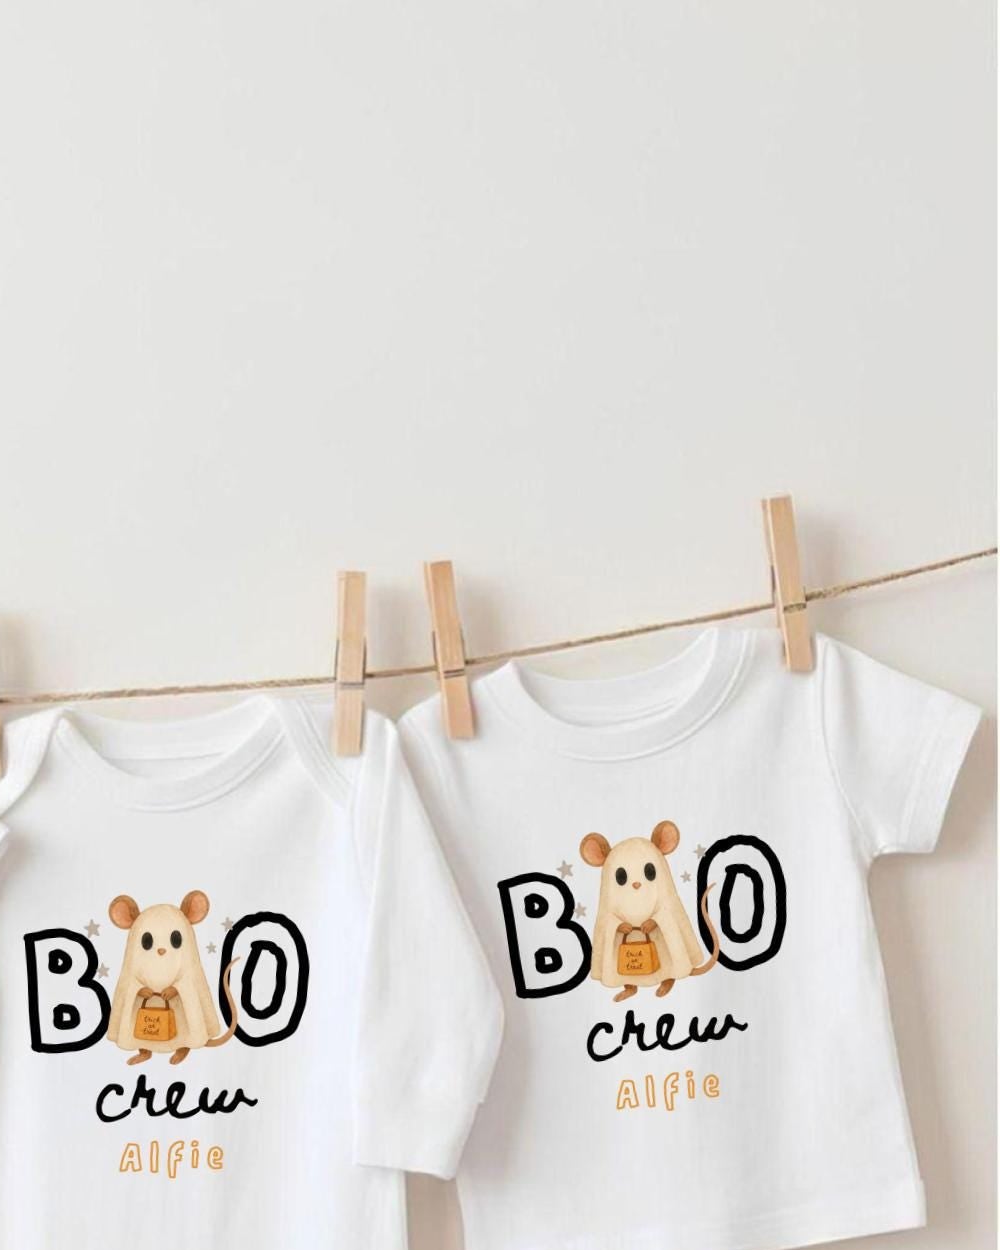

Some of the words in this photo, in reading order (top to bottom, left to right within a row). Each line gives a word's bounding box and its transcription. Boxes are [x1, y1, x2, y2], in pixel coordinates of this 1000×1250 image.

[586, 1009, 749, 1063] crew
[95, 1074, 259, 1123] crew
[615, 1069, 721, 1112] Alfie
[119, 1139, 225, 1180] Alfie
